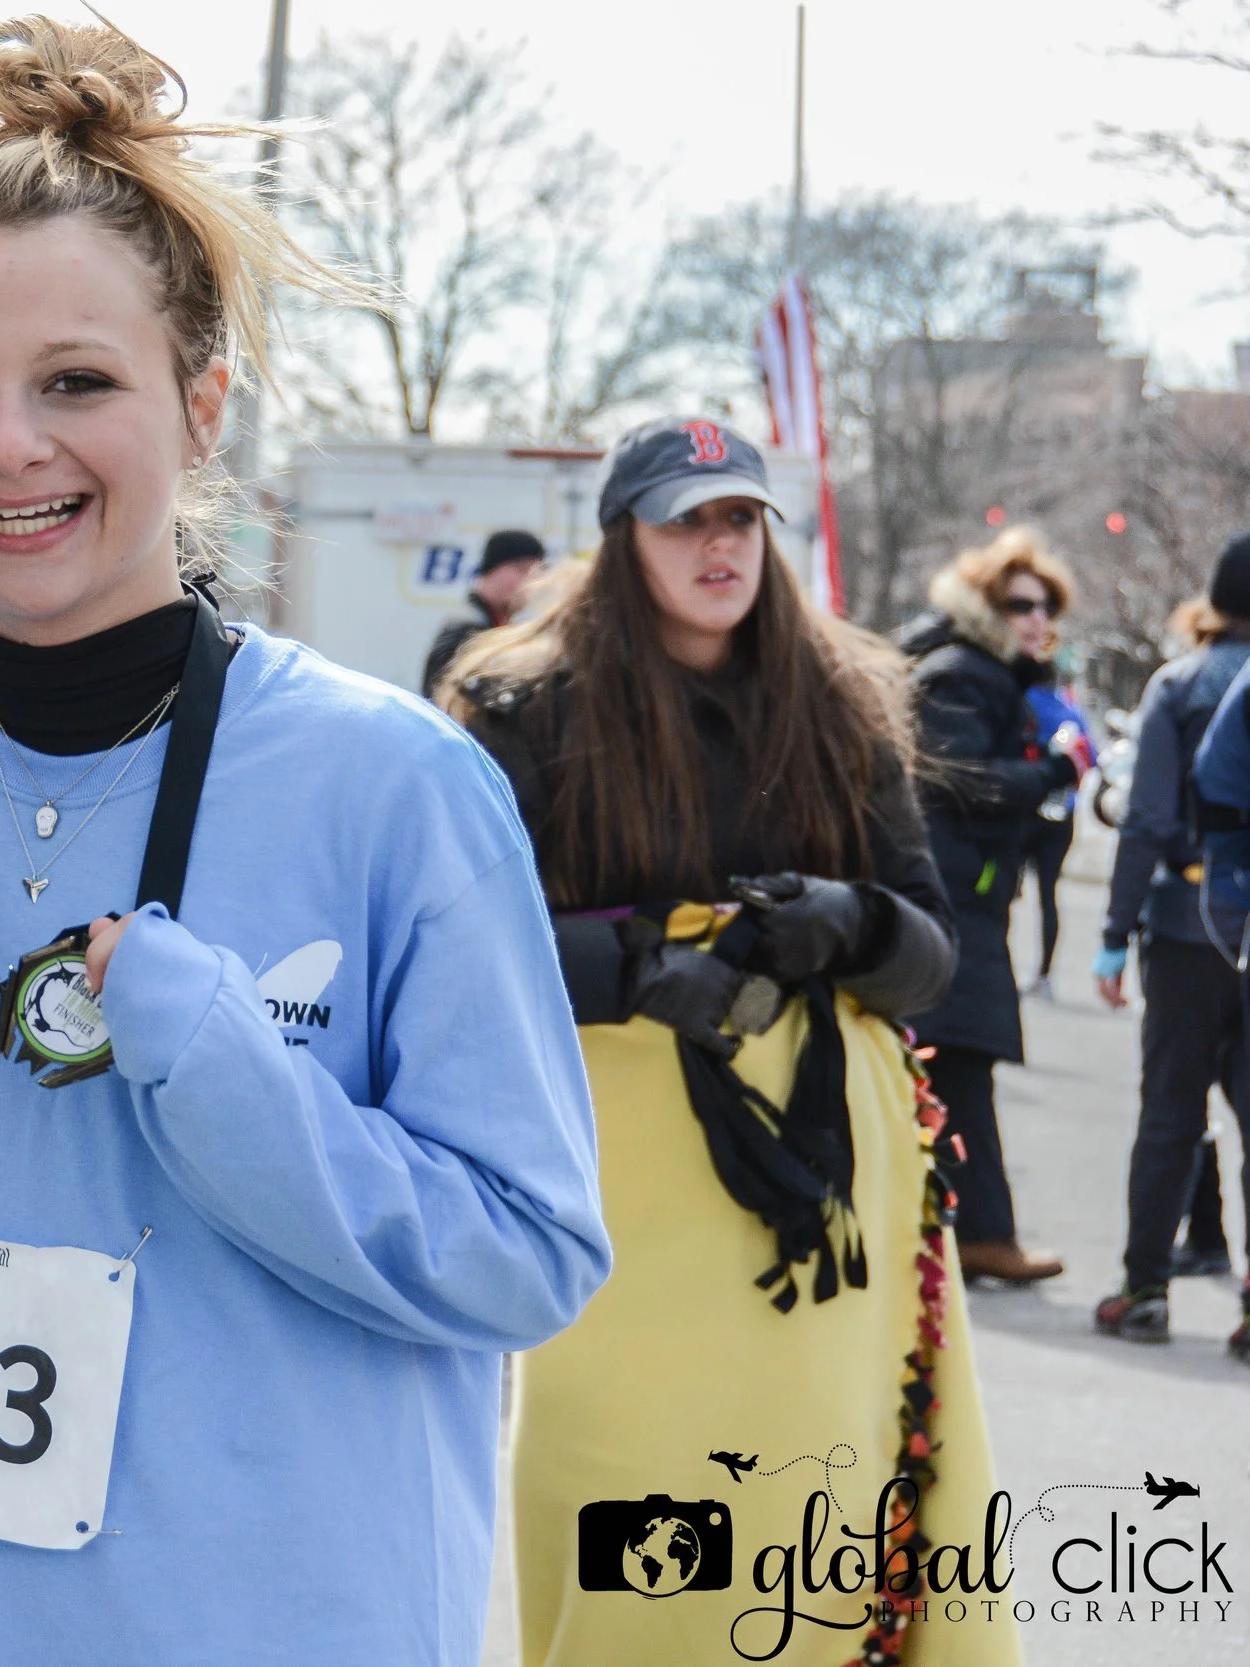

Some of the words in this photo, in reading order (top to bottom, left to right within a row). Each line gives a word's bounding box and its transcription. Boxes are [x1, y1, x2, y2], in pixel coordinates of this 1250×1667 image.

[681, 421, 728, 463] B
[53, 1003, 96, 1038] FINISHER
[264, 998, 331, 1029] OWN
